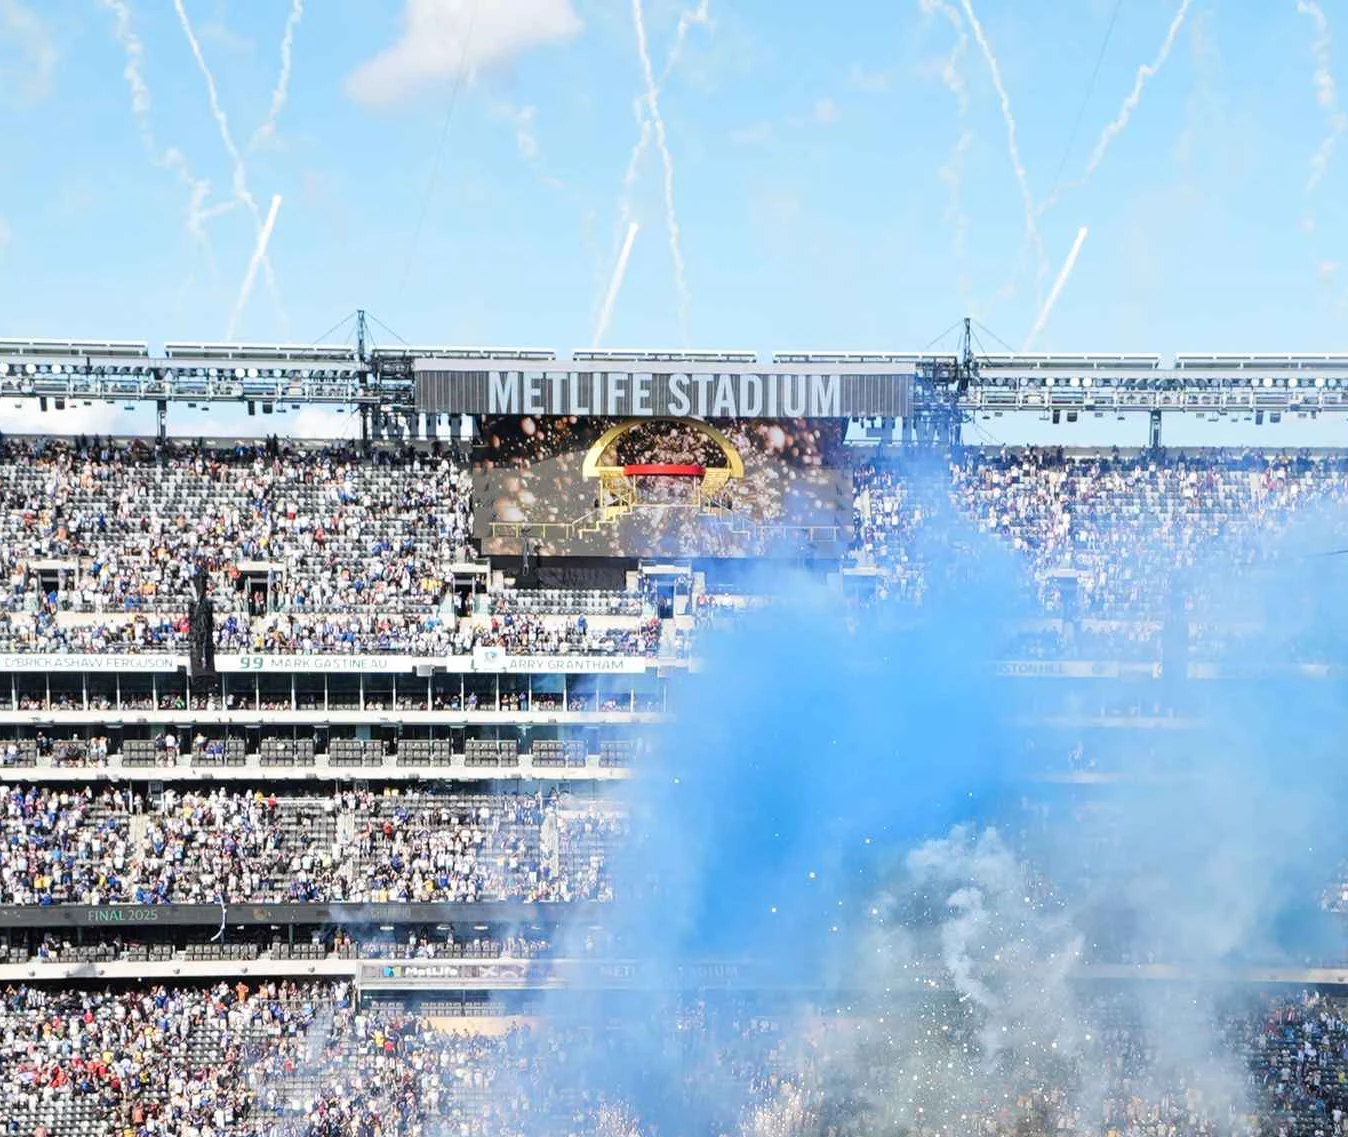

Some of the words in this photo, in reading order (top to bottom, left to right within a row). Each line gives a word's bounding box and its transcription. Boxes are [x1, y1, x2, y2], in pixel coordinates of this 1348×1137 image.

[489, 371, 653, 415] METLIFE
[668, 373, 839, 417] STADIUM
[106, 657, 173, 668] FERGUSON
[240, 656, 263, 669] 99
[271, 658, 310, 668] MARK
[314, 658, 388, 668] GASTINEAU
[509, 659, 544, 669] ARRY
[548, 659, 624, 669] GRANTHAM
[88, 910, 125, 921] FINAL
[128, 909, 158, 920] 2025
[405, 966, 458, 977] MetLife
